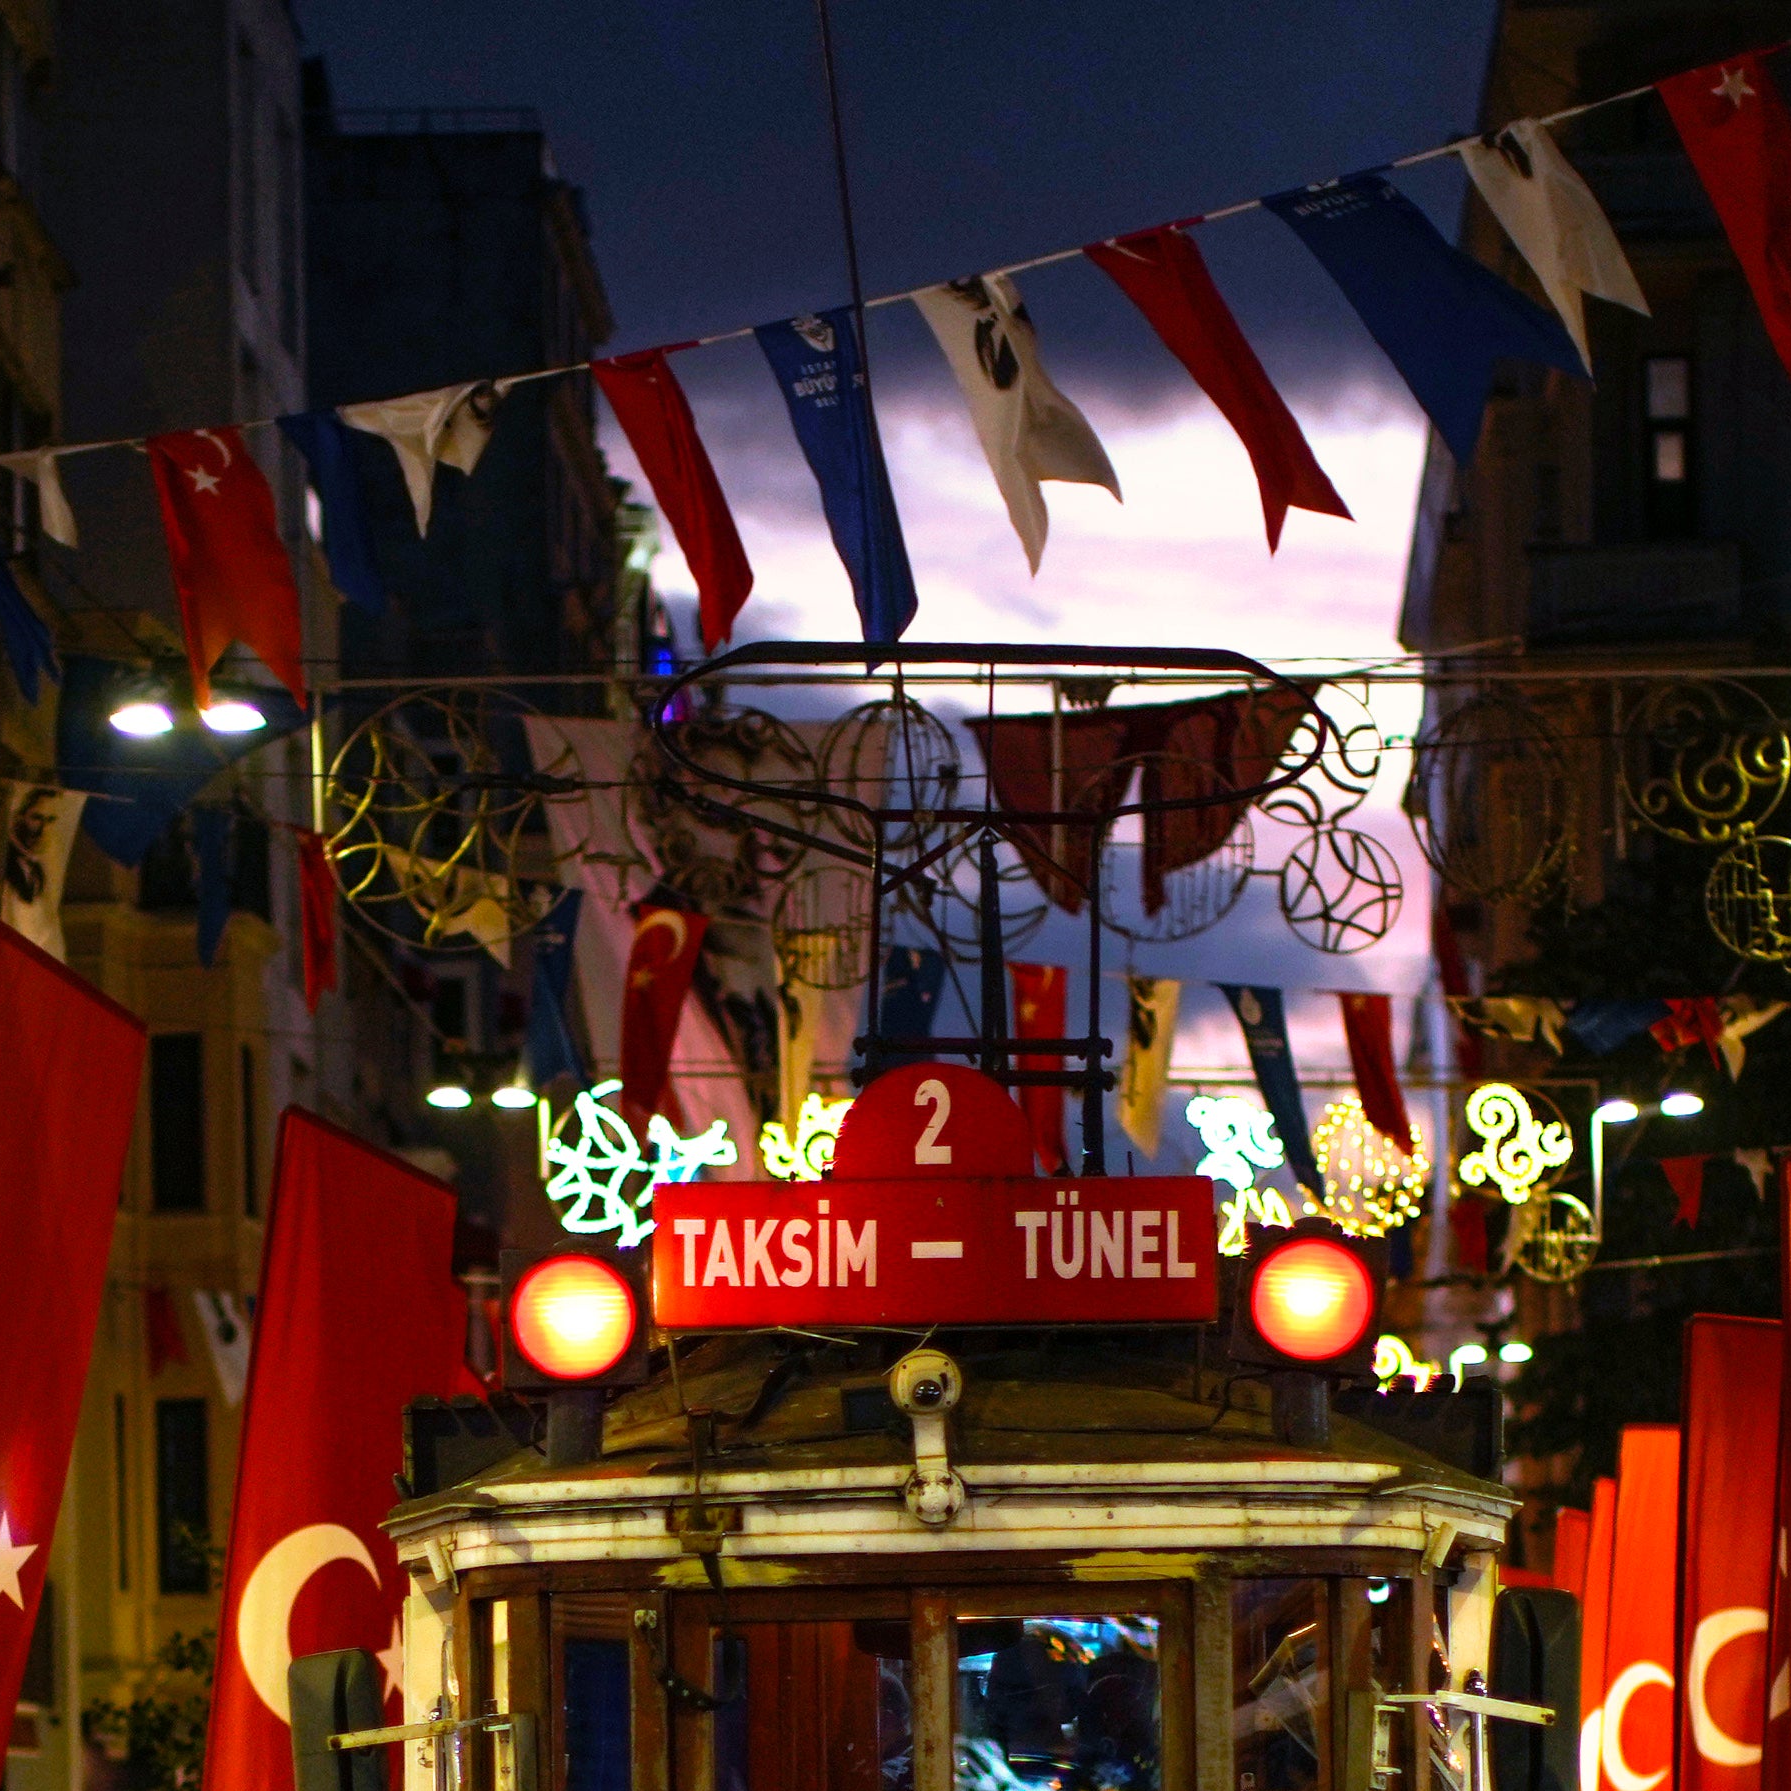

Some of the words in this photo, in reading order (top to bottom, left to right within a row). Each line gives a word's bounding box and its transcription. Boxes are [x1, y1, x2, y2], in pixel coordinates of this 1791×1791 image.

[913, 1078, 952, 1165] 2
[674, 1198, 878, 1289] TAKSİM
[1014, 1190, 1197, 1280] TÜNEL
